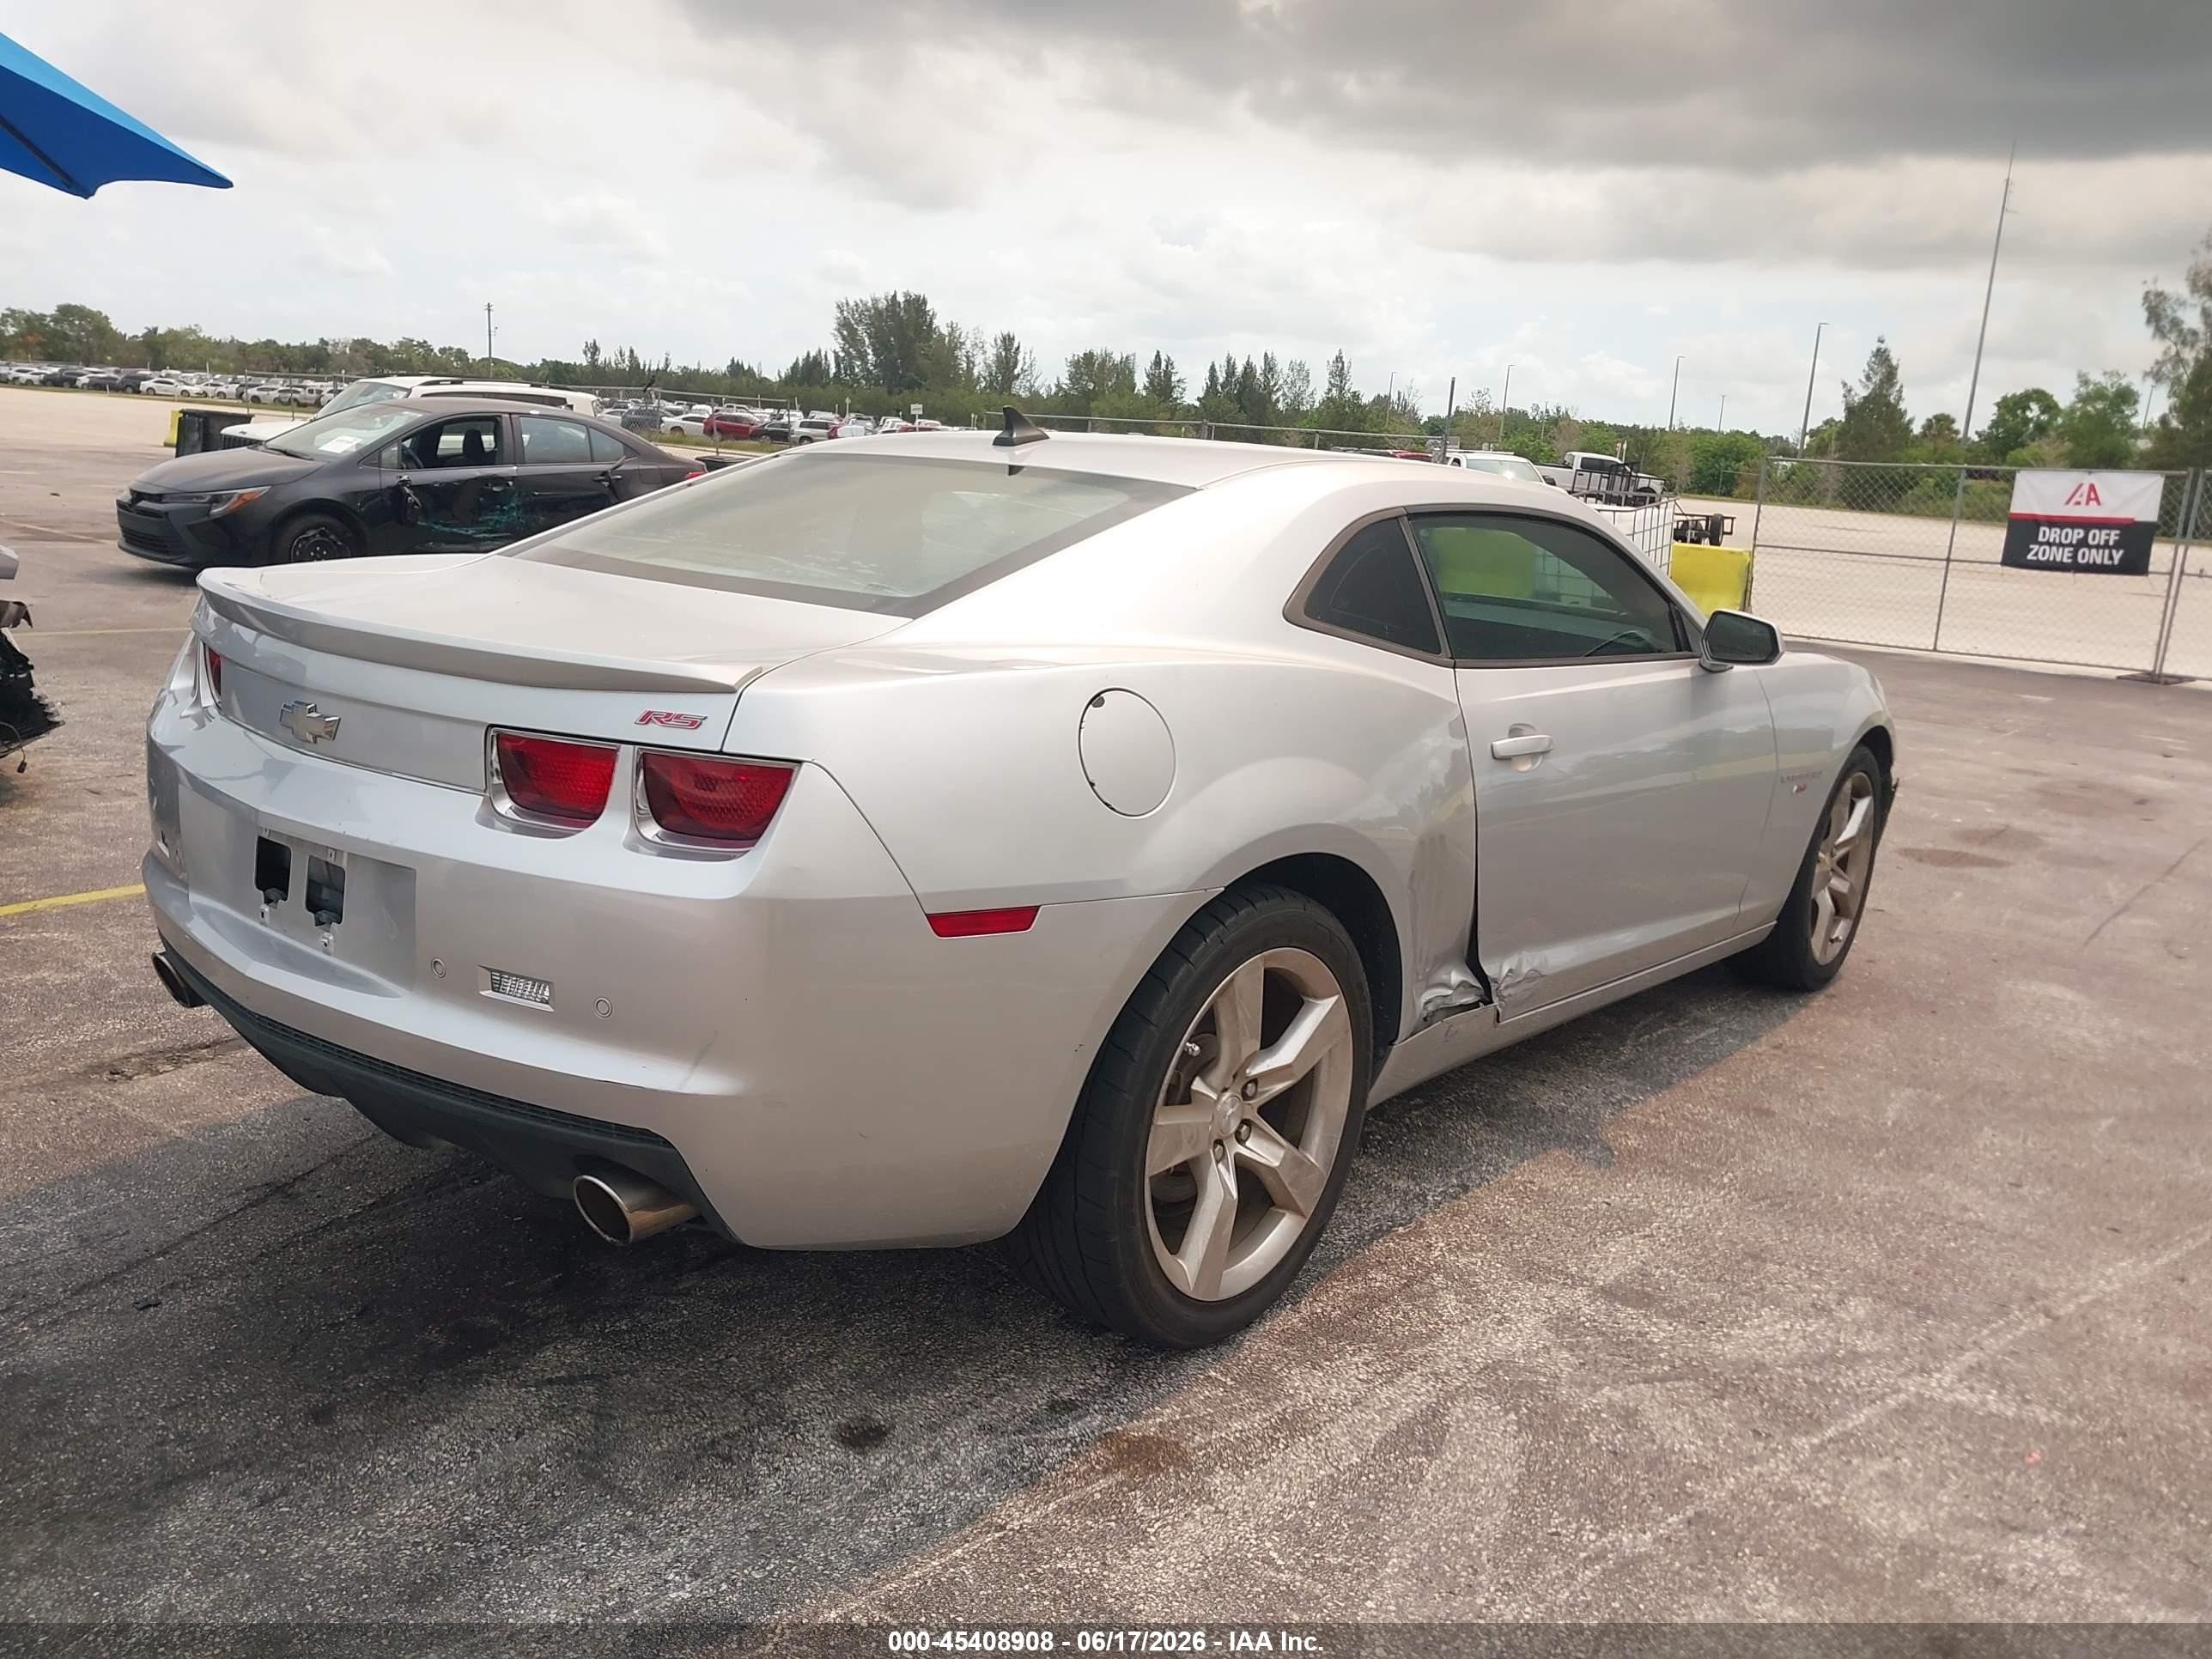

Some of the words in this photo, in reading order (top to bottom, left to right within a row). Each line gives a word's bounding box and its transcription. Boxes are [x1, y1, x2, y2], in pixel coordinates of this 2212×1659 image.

[2038, 527, 2084, 544] DROP
[2087, 529, 2120, 546] OFF
[2027, 544, 2074, 562] ZONE
[2076, 547, 2124, 566] ONLY
[634, 708, 708, 730] RS
